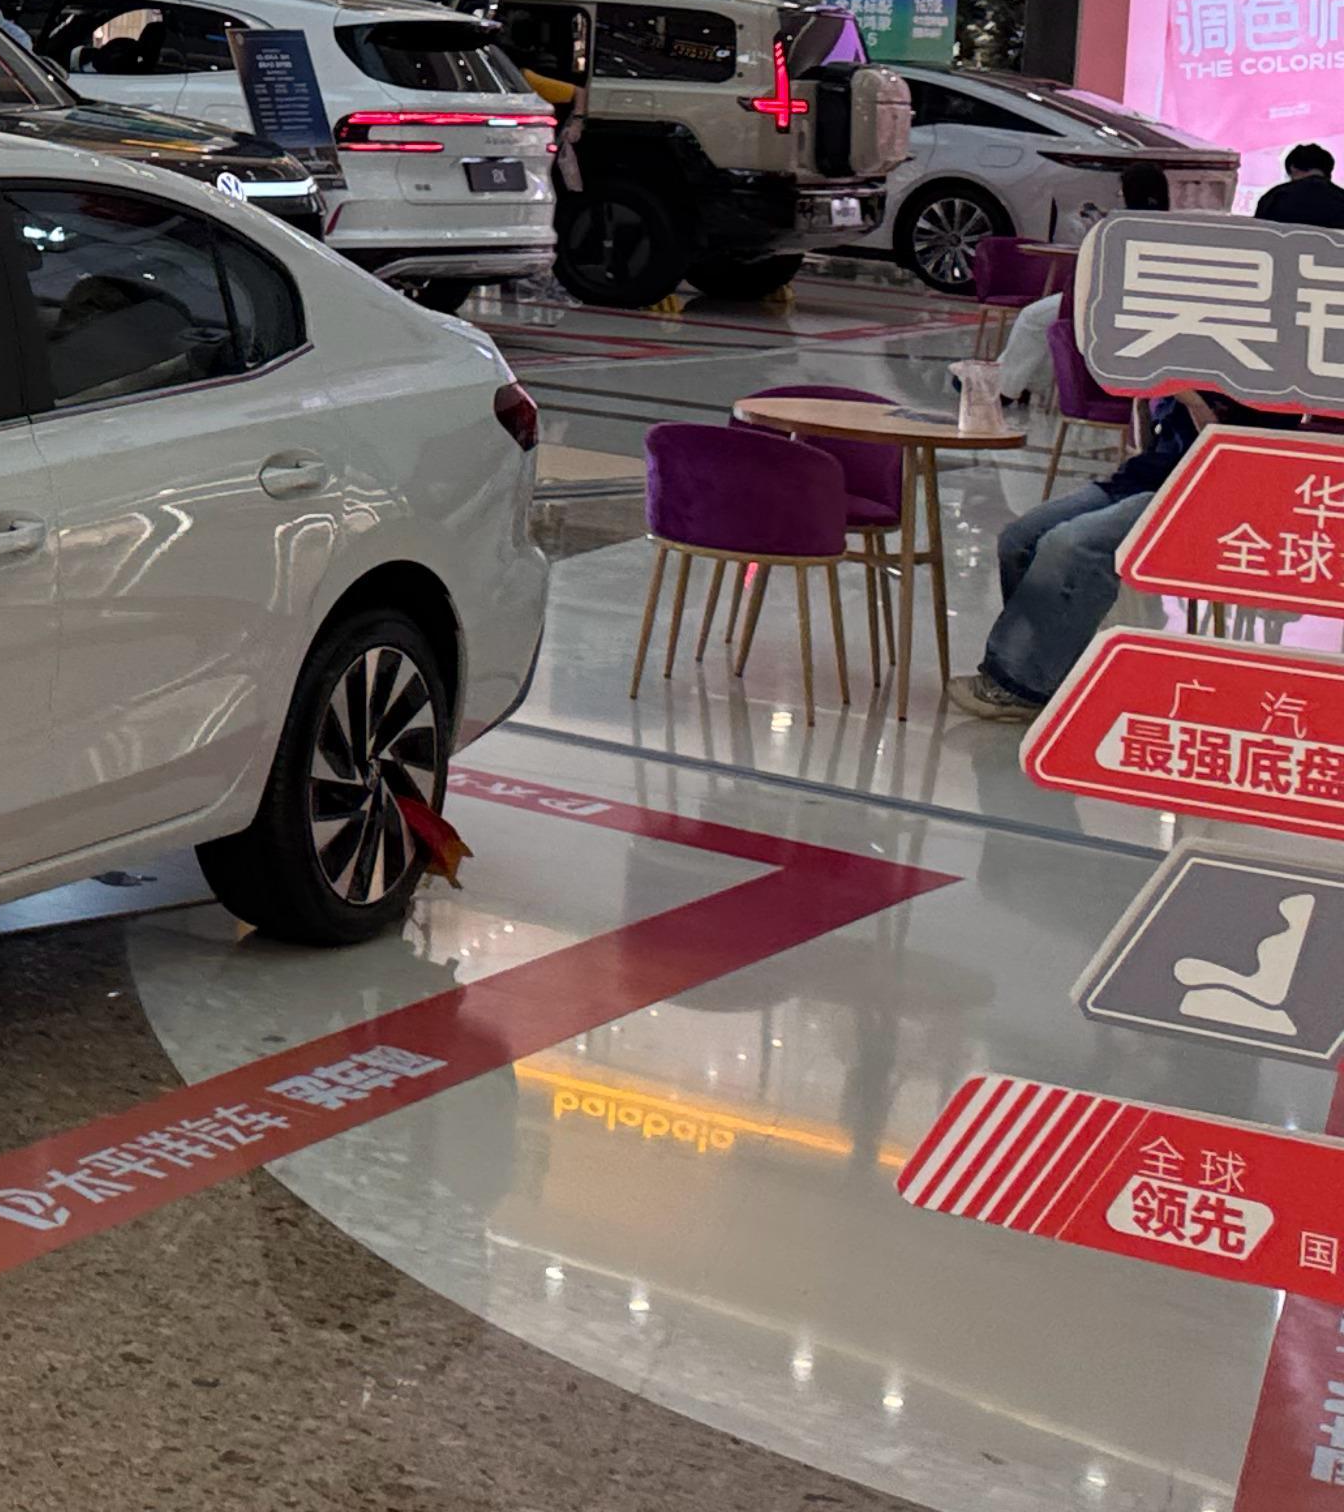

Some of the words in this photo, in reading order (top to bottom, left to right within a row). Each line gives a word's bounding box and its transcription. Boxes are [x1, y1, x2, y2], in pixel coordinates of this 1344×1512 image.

[1179, 59, 1234, 81] THE
[1119, 717, 1344, 796] 最强底盘
[43, 1102, 291, 1205] 太平洋汽车
[1137, 1135, 1248, 1194] 全球
[1131, 1180, 1247, 1256] 领先
[1298, 1229, 1339, 1275] 国
